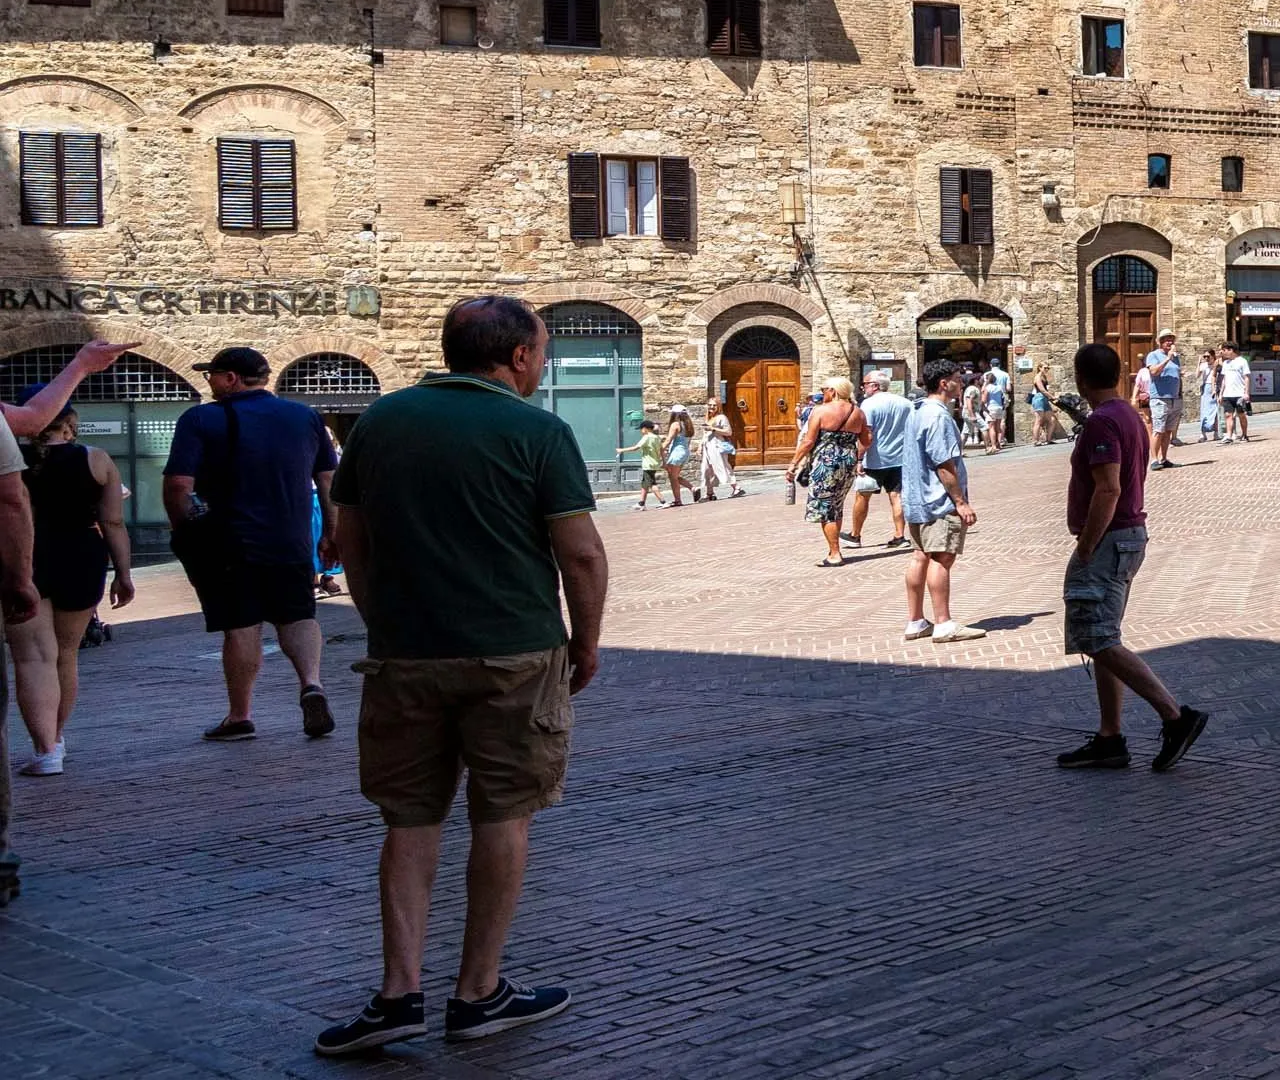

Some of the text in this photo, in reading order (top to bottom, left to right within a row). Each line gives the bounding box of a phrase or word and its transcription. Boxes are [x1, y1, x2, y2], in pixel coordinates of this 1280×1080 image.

[0, 286, 337, 314] BANCA CR FIRENZE
[928, 325, 1001, 335] Gelateria Dondoli
